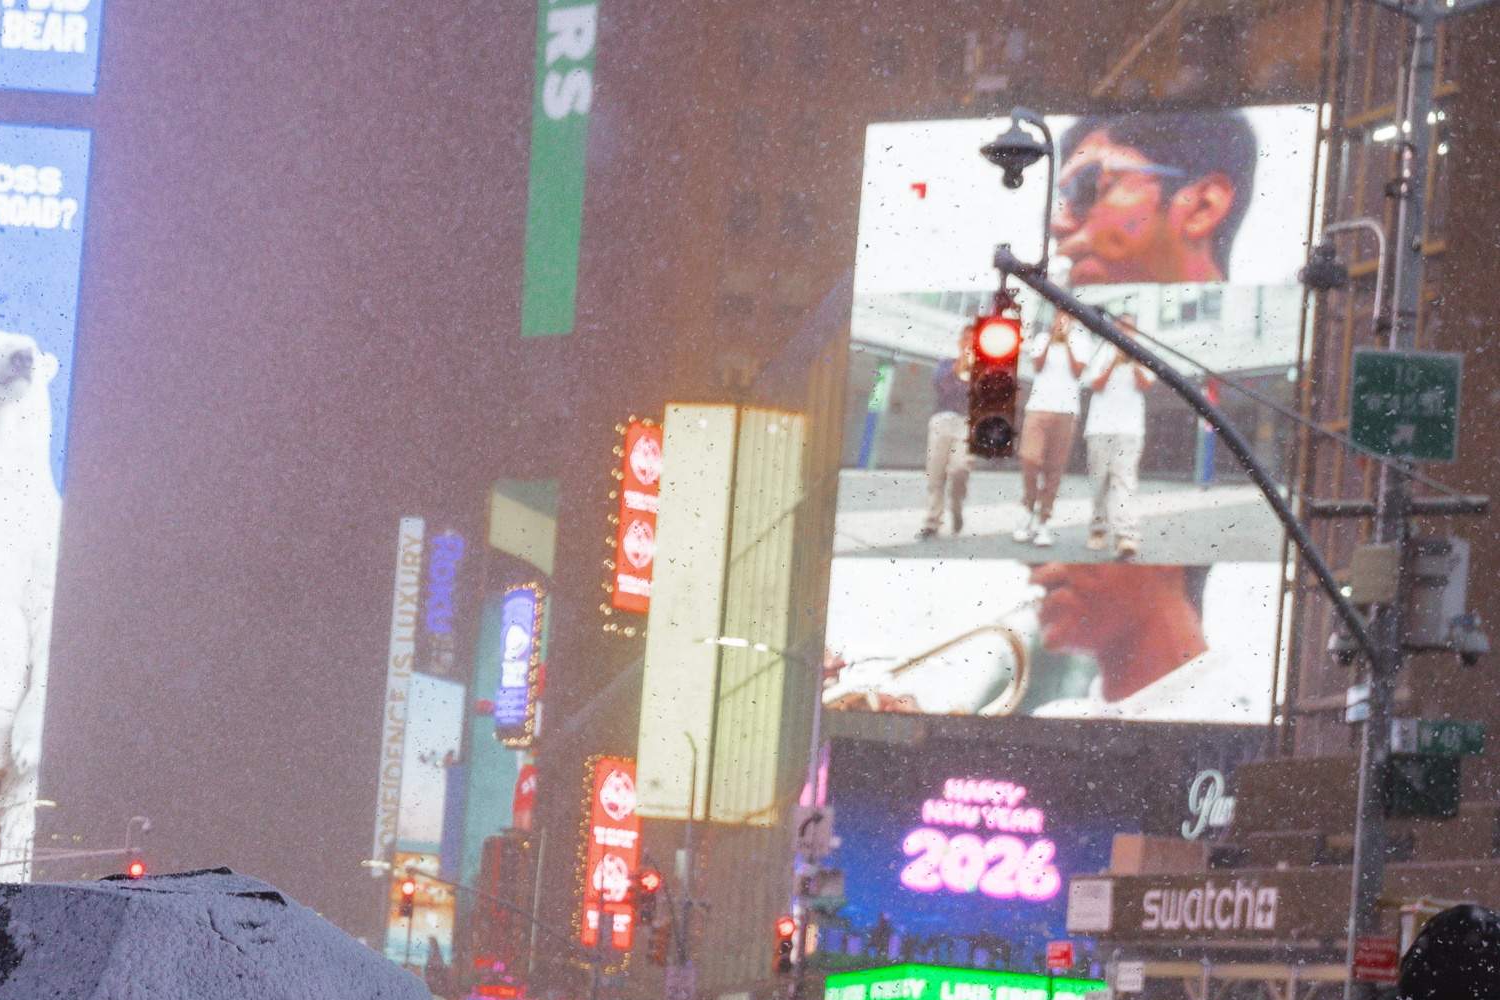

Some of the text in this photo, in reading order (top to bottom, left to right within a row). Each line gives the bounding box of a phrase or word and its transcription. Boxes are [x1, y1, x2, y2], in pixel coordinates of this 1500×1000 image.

[1, 9, 88, 54] BEAR
[543, 0, 597, 120] RS
[378, 533, 421, 849] ONFIDENCE IS LUXURY
[921, 798, 1044, 833] NEW YEAR
[943, 778, 1027, 808] HAPPY
[900, 827, 1062, 903] 2026
[1141, 879, 1255, 930] swatch
